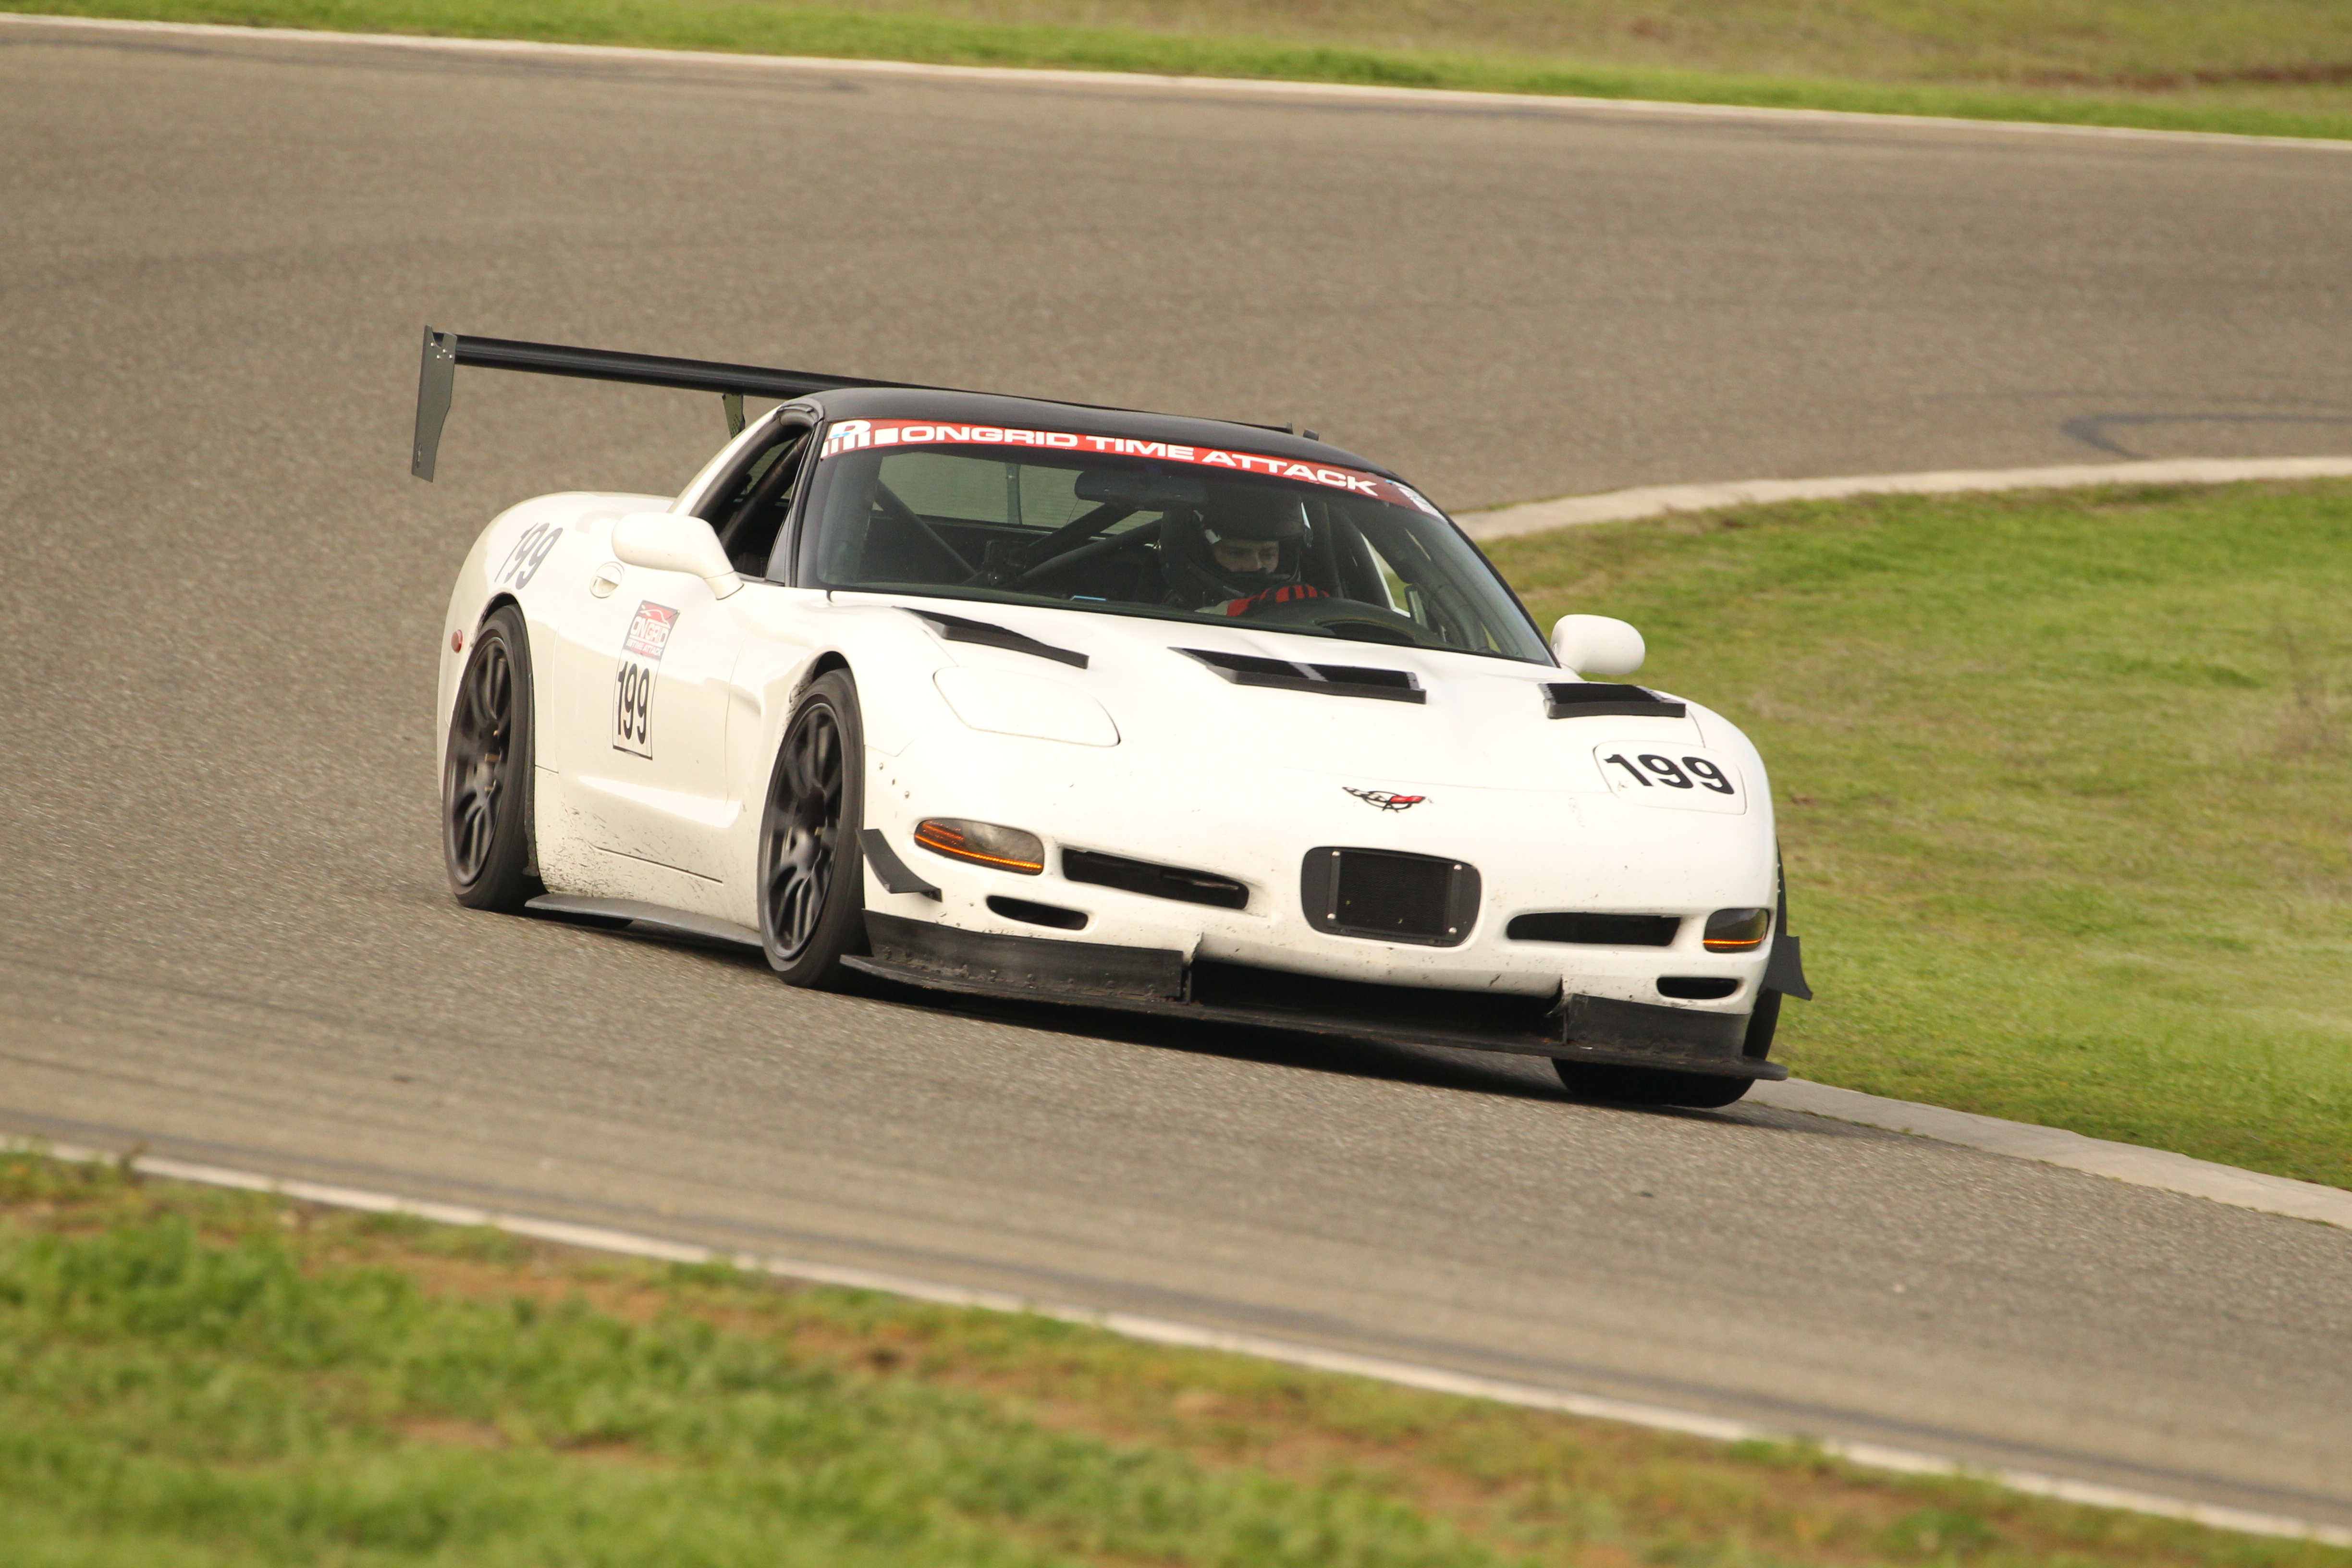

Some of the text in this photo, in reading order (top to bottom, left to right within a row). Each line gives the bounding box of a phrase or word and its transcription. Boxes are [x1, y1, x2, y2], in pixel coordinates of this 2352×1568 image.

[901, 426, 1078, 447] ONGRID
[1086, 435, 1194, 460] TIME
[1201, 450, 1379, 497] ATTACK
[494, 522, 563, 590] 199
[642, 644, 662, 657] ATTACK
[618, 661, 649, 745] 199
[1603, 754, 1735, 795] 199
